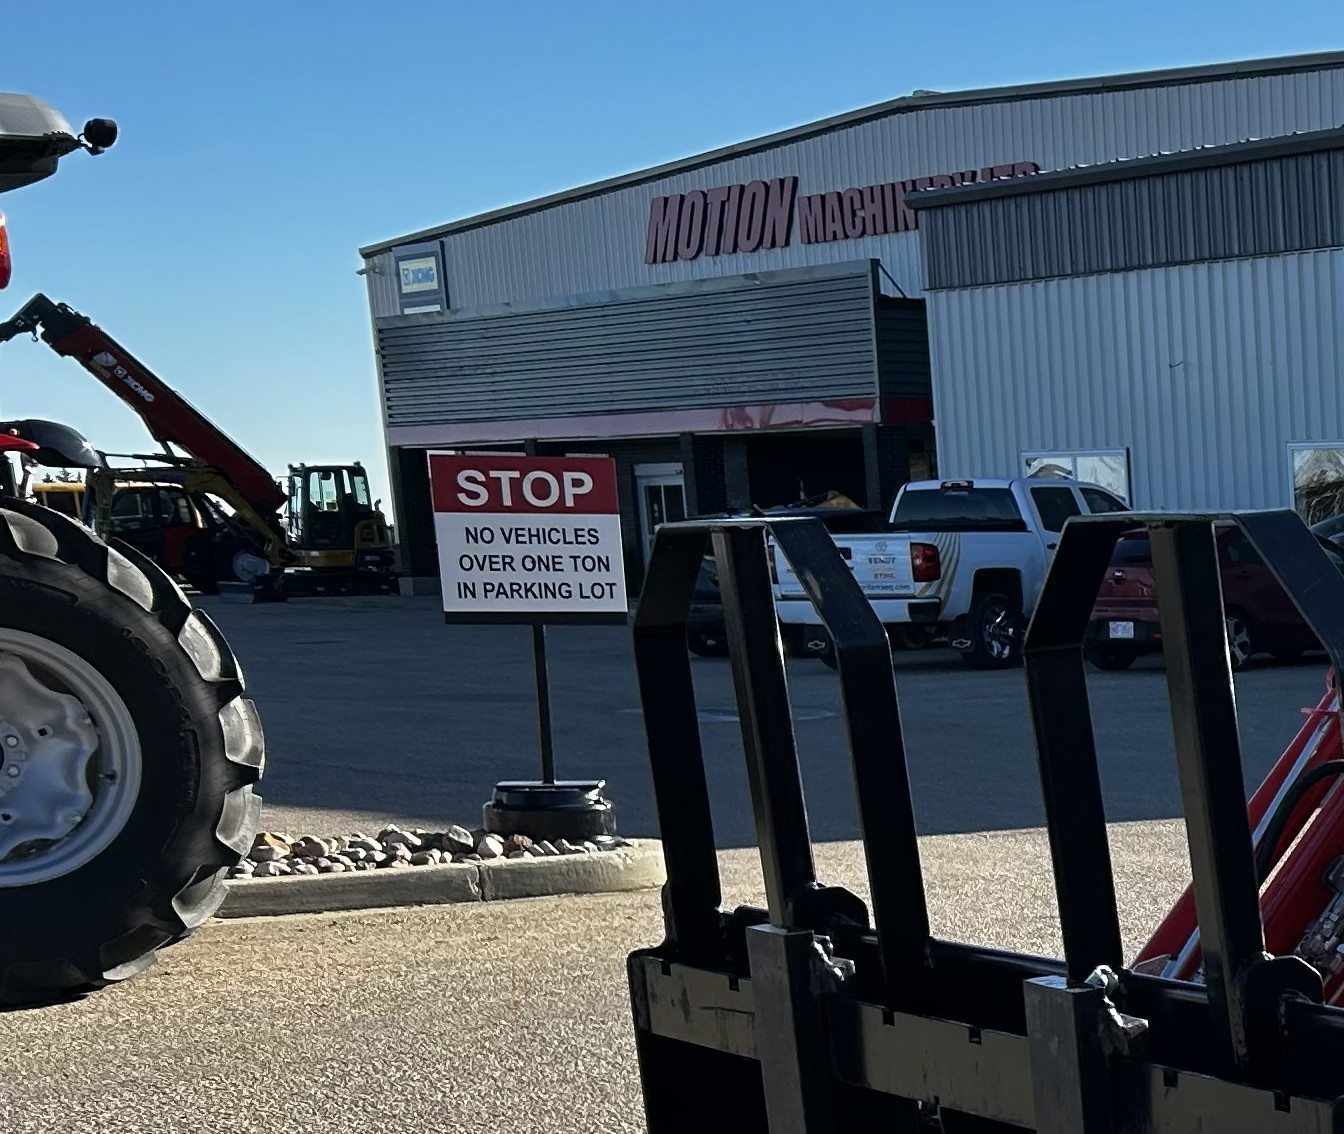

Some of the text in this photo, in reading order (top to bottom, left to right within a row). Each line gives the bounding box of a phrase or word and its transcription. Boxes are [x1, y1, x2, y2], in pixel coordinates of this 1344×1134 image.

[645, 176, 798, 264] MOTION
[457, 469, 594, 507] STOP
[465, 527, 600, 545] NO VEHICLES
[459, 554, 610, 572] OVER ONE TON
[457, 582, 617, 599] IN PARKING LOT
